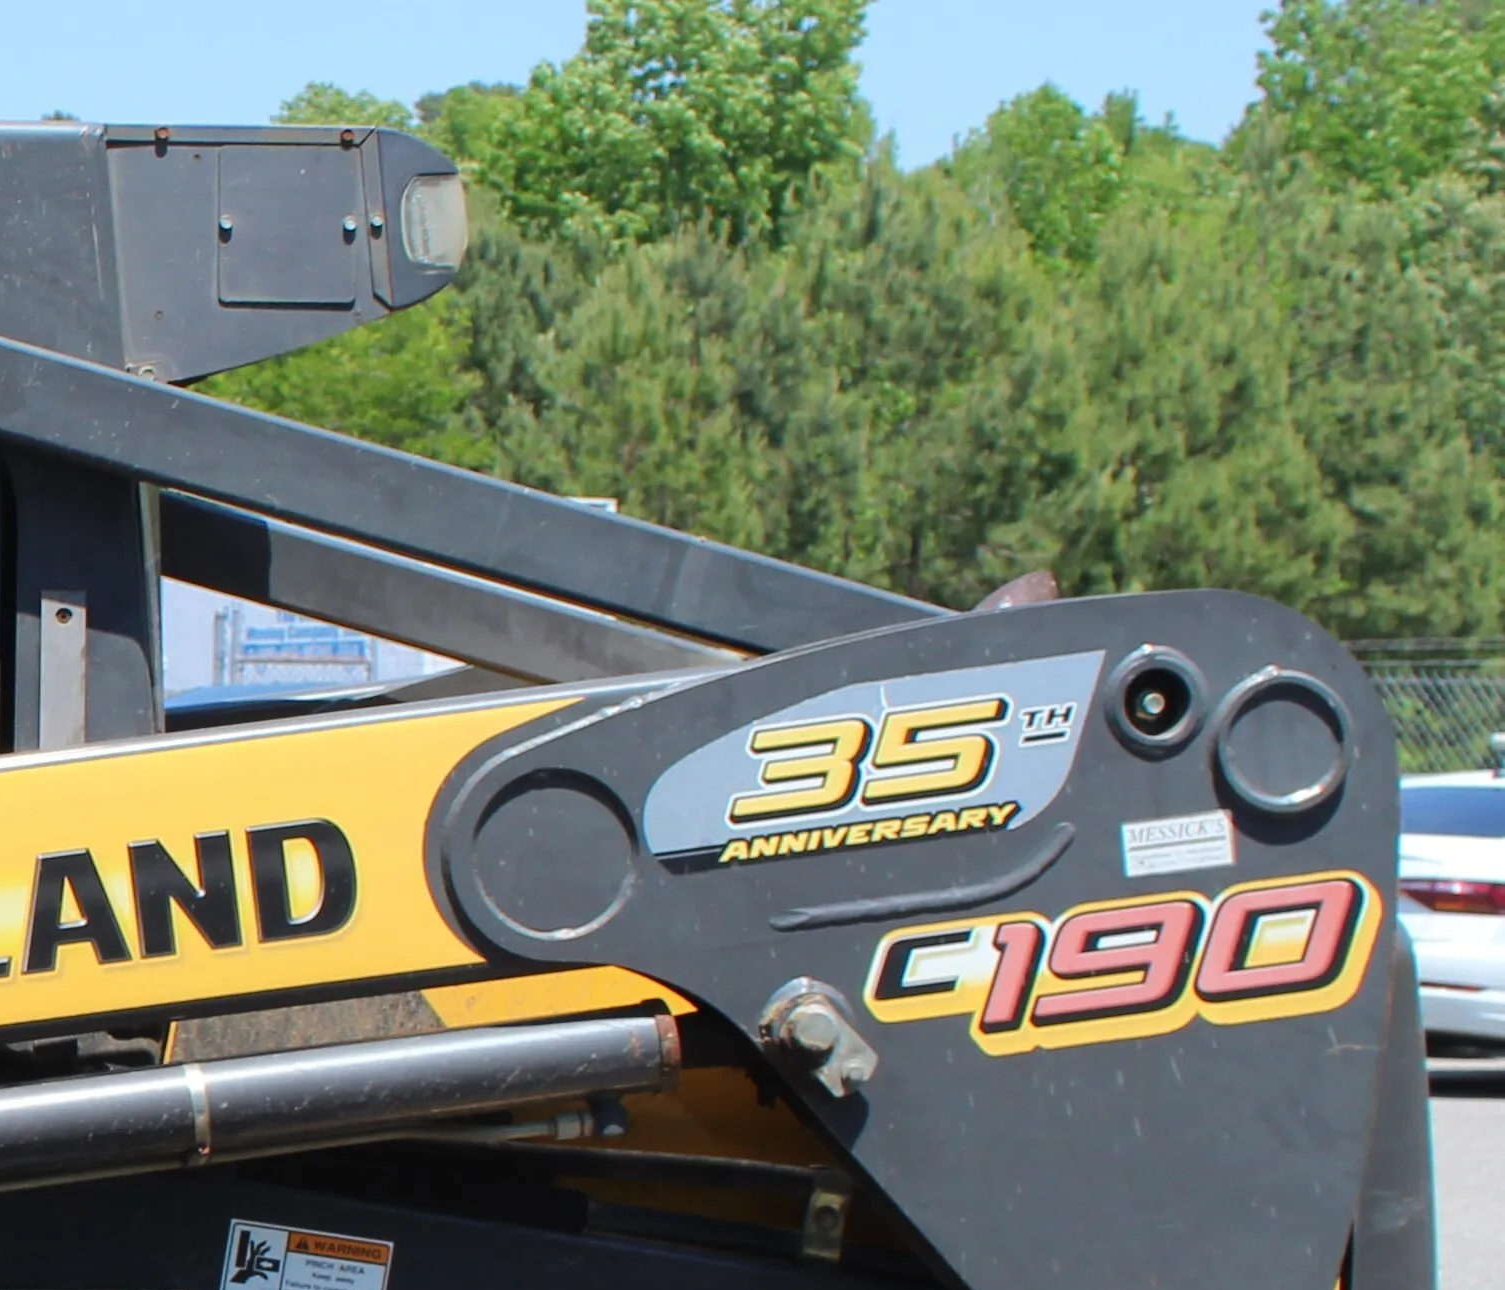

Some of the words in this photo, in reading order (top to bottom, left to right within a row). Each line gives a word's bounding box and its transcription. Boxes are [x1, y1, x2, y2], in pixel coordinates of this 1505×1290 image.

[728, 693, 1010, 826] 35
[1020, 703, 1075, 731] TH
[719, 801, 1022, 864] ANNIVERSARY
[1128, 818, 1226, 845] MESSICK'S
[868, 876, 1368, 1038] C190
[305, 1259, 334, 1270] PINCH
[339, 1264, 365, 1275] AREA
[314, 1240, 382, 1260] WARNING
